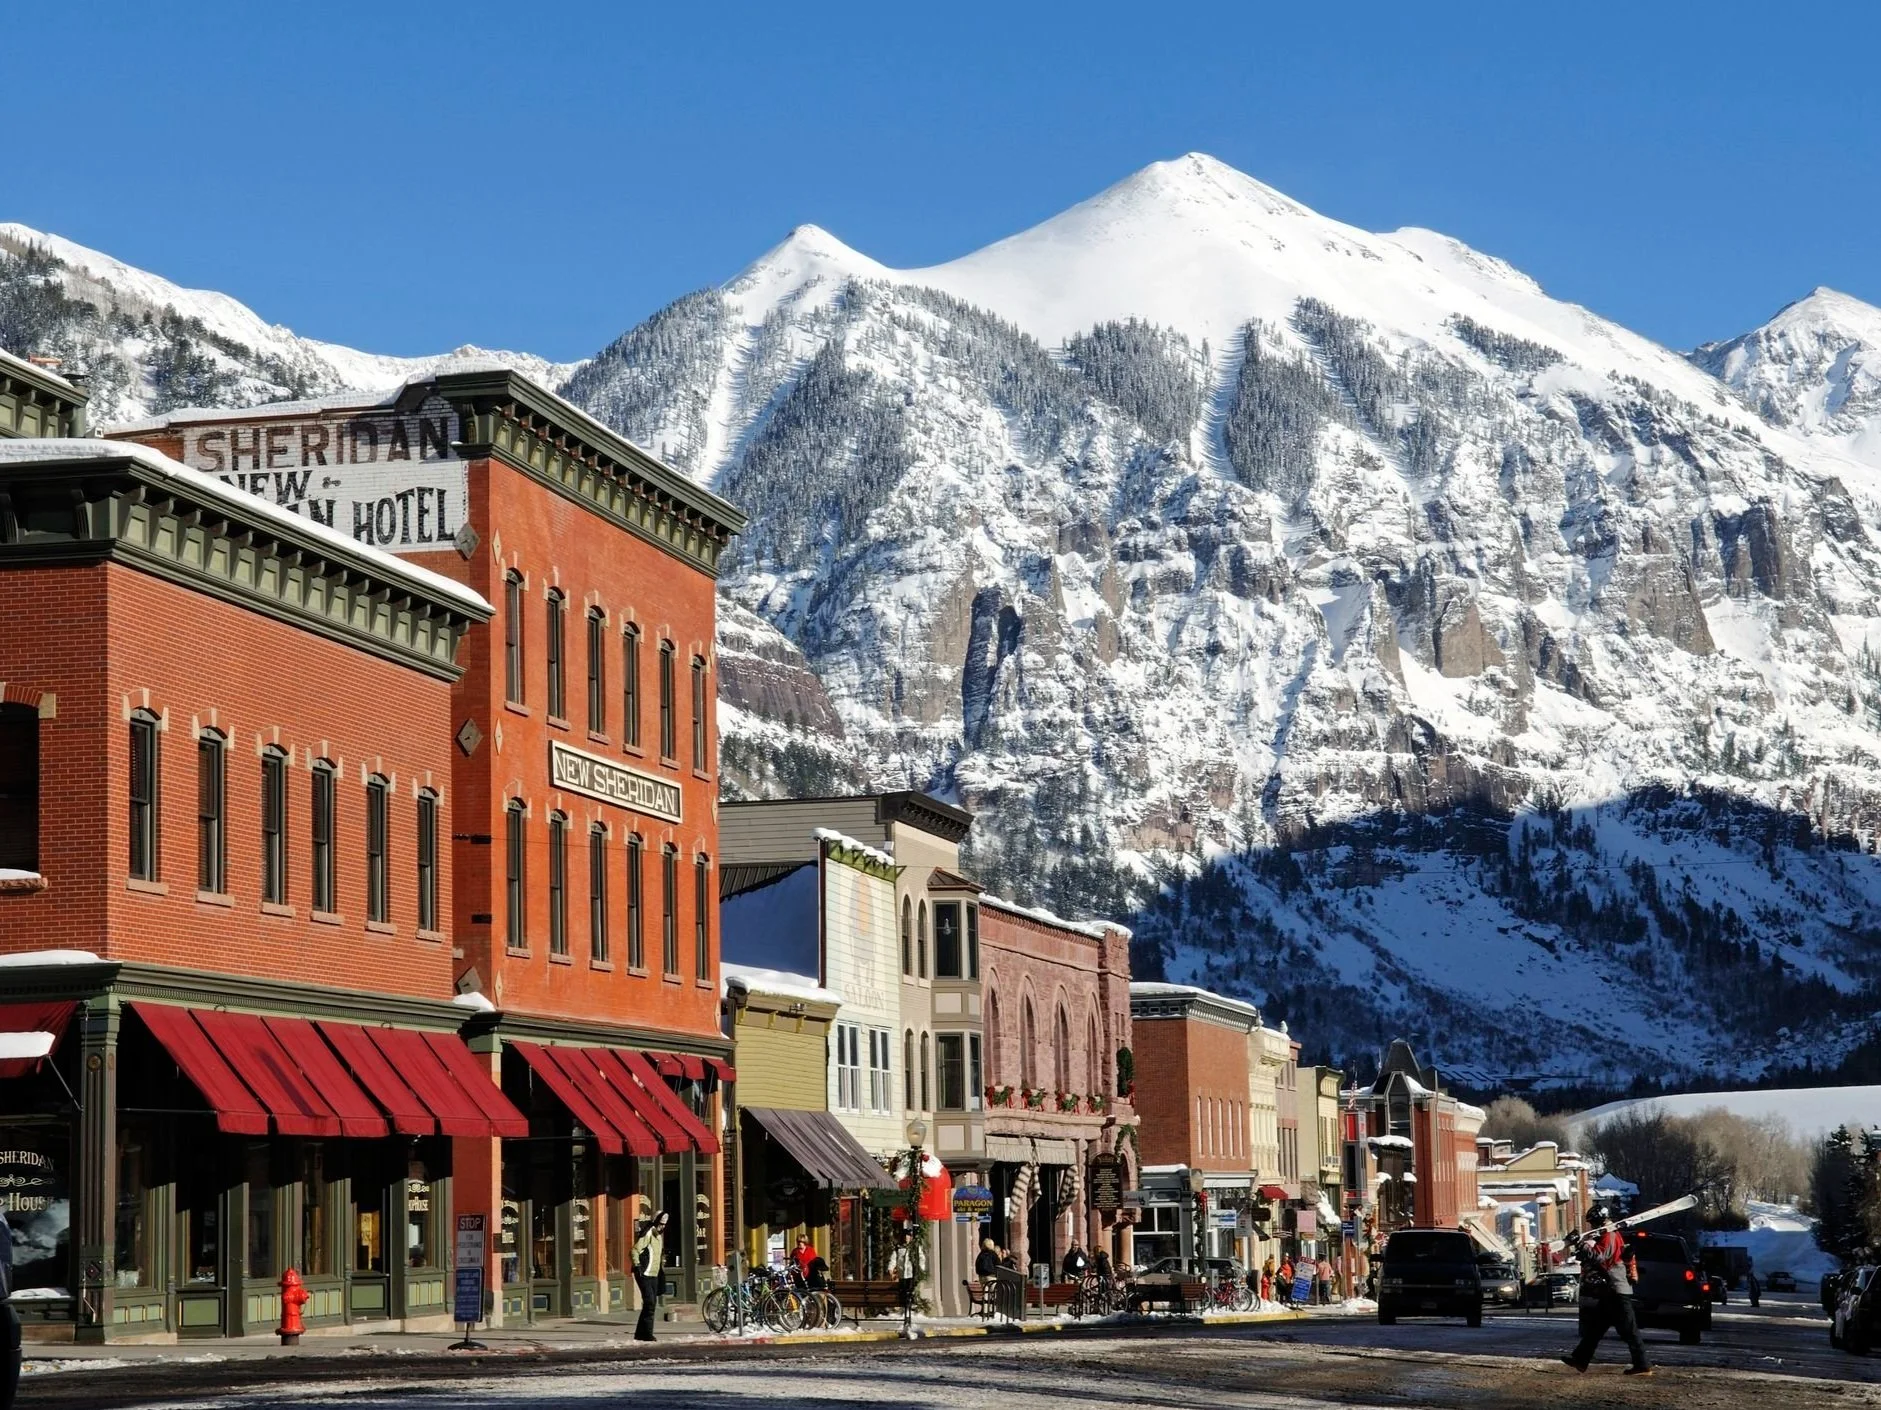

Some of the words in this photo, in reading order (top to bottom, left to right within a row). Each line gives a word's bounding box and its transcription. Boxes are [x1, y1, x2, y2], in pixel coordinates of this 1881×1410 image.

[196, 416, 449, 473] SHERIDAN
[352, 486, 455, 546] HOTEL
[554, 750, 589, 788] NEW
[953, 1199, 992, 1207] PARAGON
[460, 1217, 481, 1230] STOP
